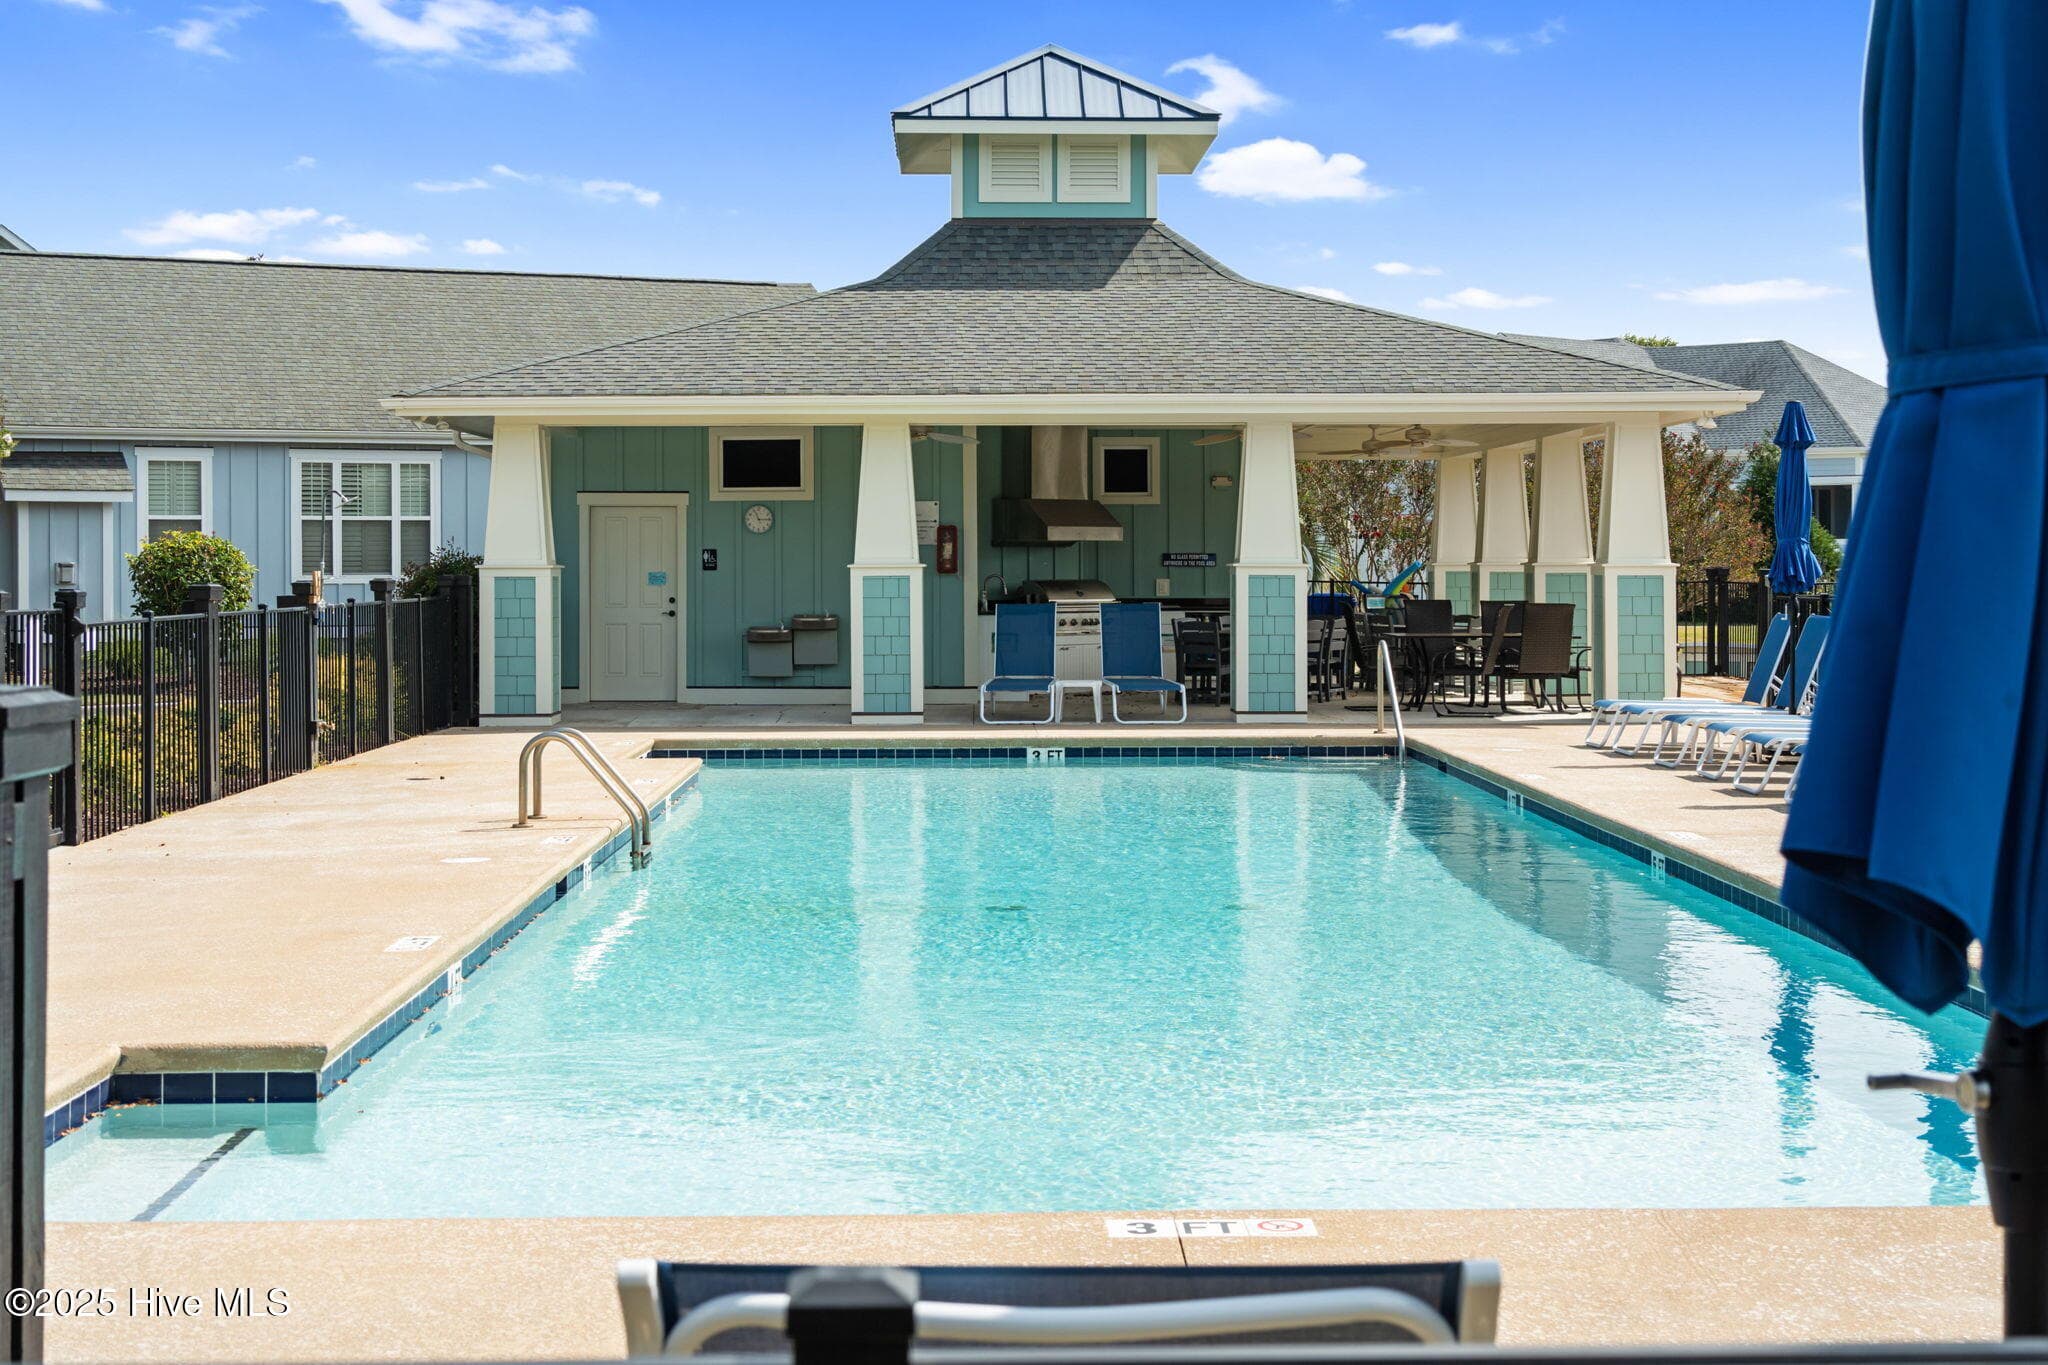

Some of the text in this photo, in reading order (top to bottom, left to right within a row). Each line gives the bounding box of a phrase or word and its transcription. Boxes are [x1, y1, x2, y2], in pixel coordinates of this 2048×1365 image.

[1047, 750, 1063, 759] FT
[1126, 1221, 1238, 1235] 3 FT
